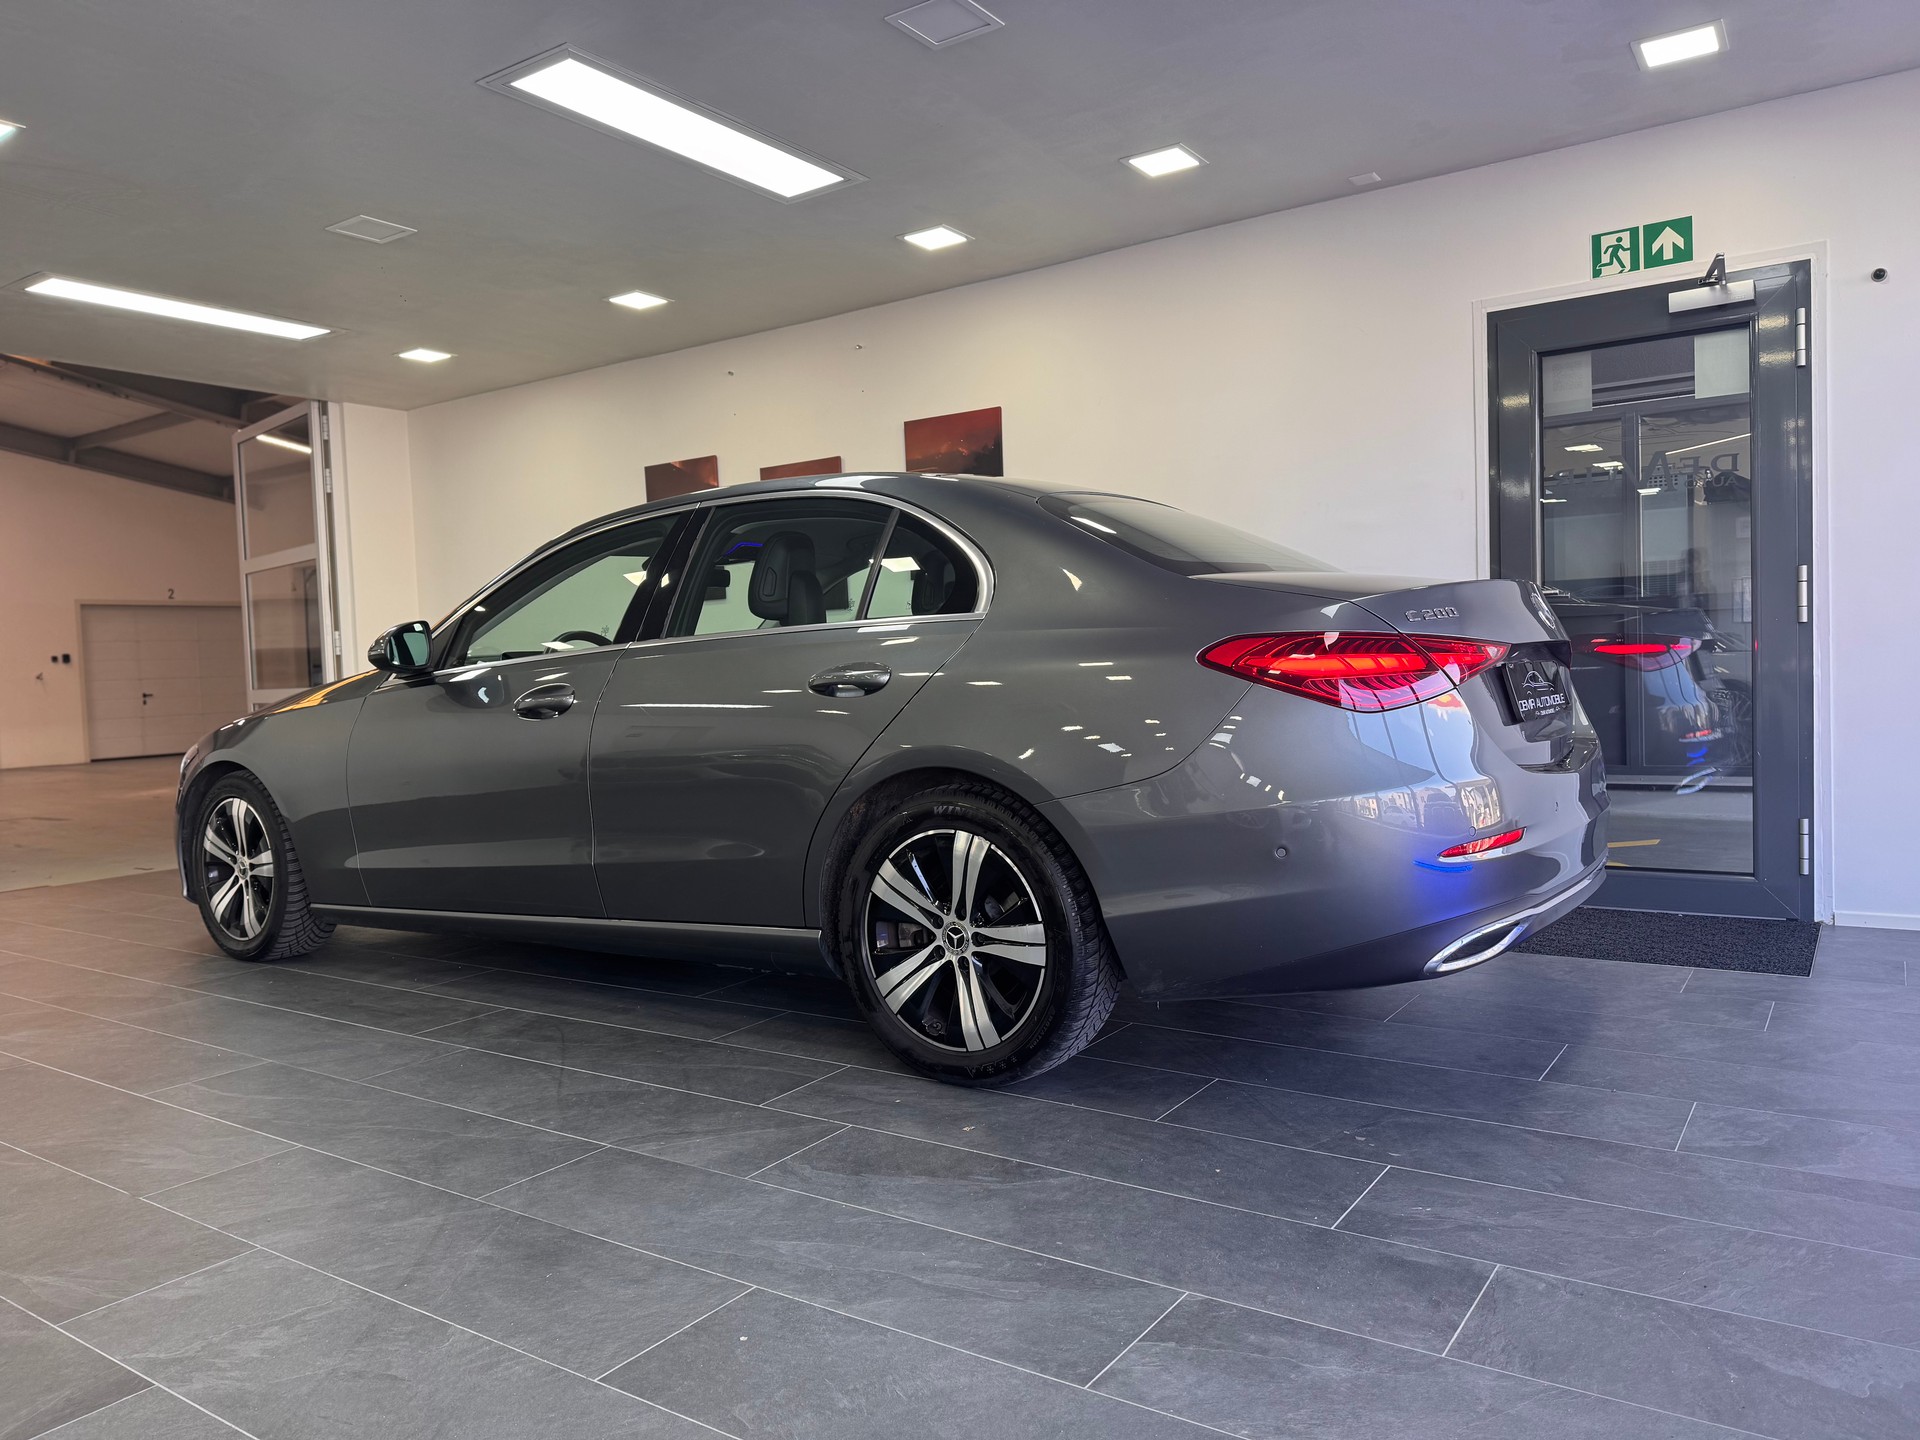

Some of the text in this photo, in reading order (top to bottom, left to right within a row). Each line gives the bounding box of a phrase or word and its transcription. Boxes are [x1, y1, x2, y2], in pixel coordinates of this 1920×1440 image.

[168, 588, 175, 600] 2
[1405, 606, 1460, 622] C 200
